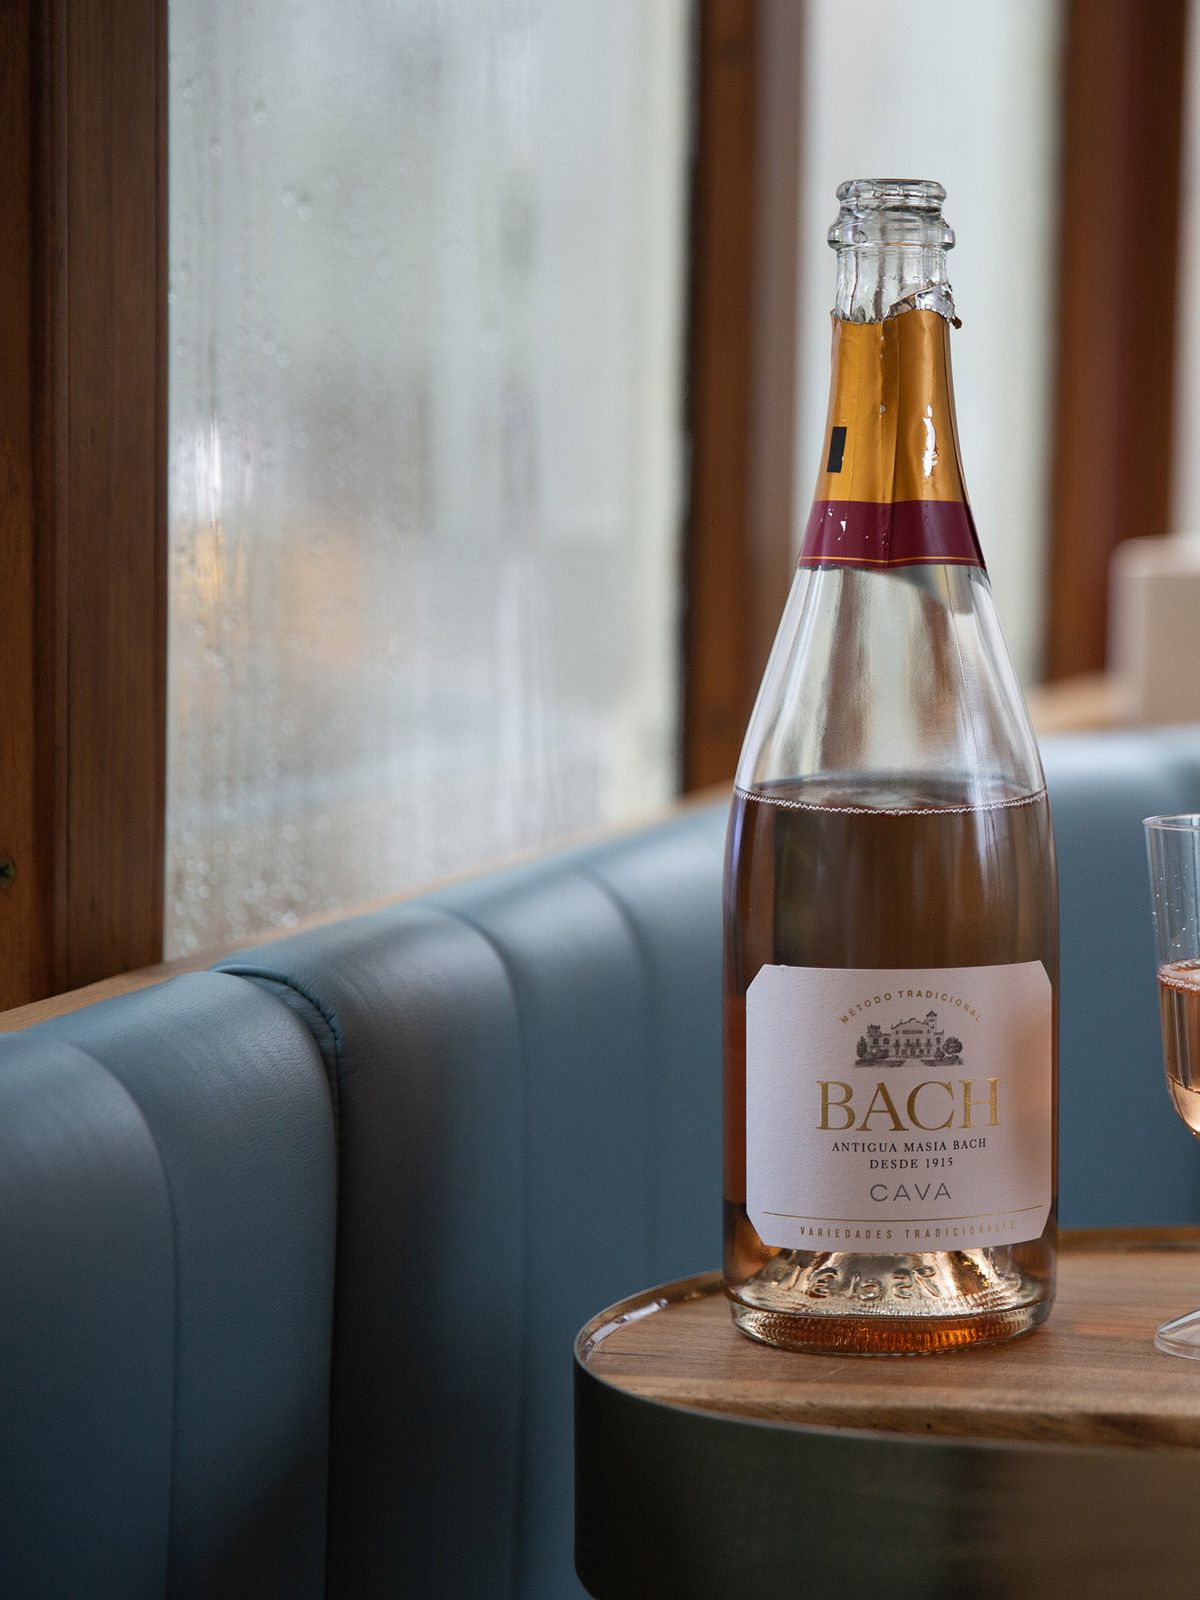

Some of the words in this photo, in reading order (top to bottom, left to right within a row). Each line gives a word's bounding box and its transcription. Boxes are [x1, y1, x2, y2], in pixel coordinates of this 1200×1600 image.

[898, 990, 983, 1024] TRADICIONAL
[816, 1077, 1002, 1132] BACH
[832, 1141, 897, 1153] ANTIGUA
[904, 1140, 947, 1152] MASIA
[953, 1138, 986, 1150] BACH
[869, 1158, 918, 1170] DESDE
[925, 1157, 953, 1169] 1915
[870, 1182, 952, 1203] CAVA
[800, 1226, 893, 1240] VARIEDADES
[905, 1220, 1016, 1240] TRADICIONALES
